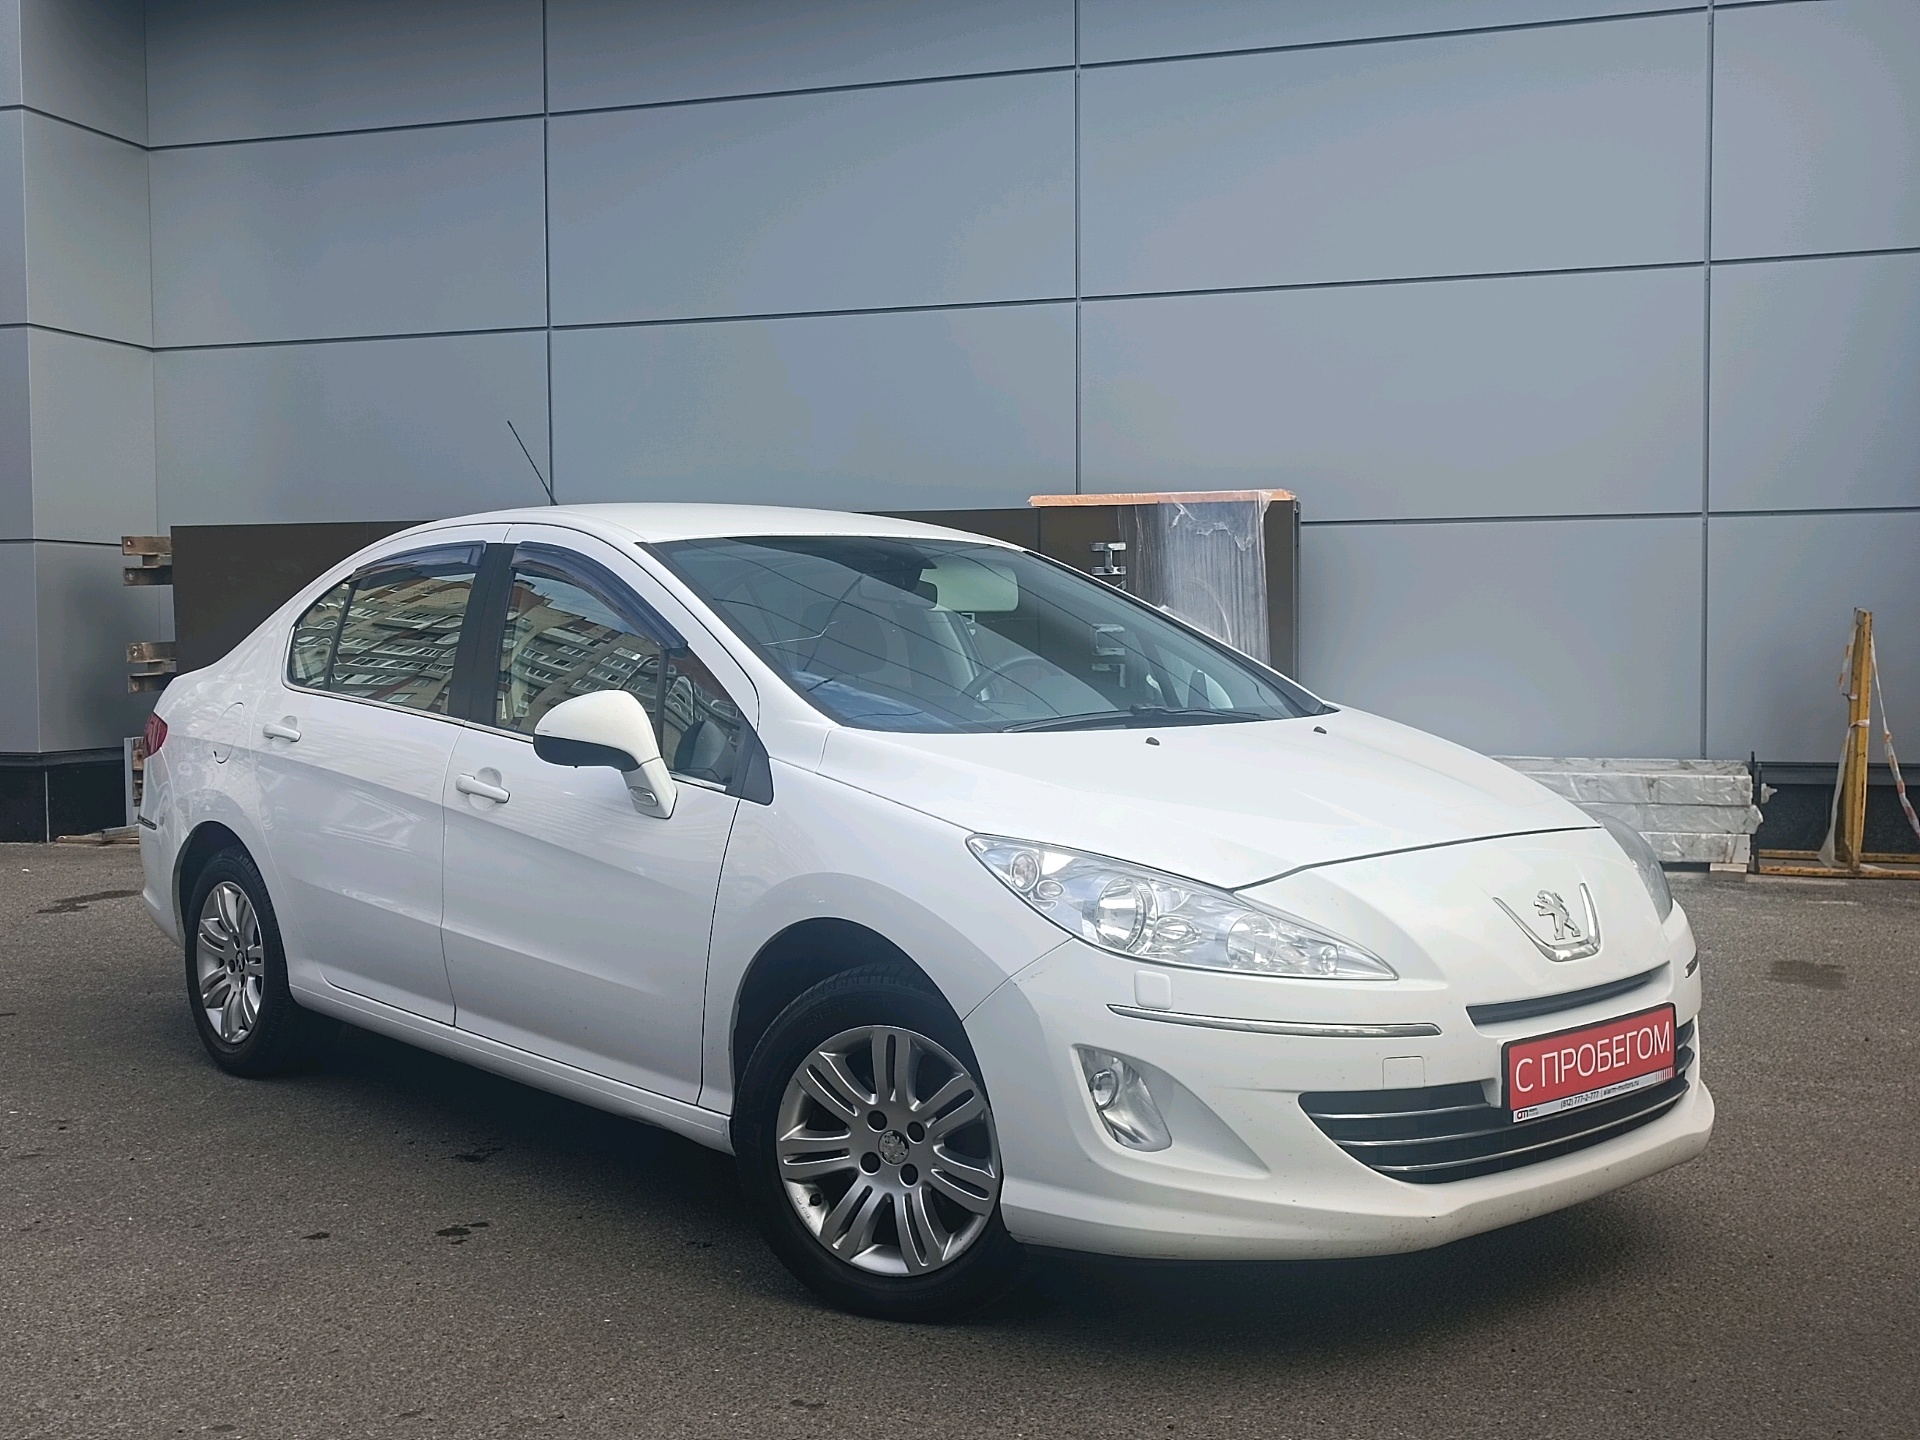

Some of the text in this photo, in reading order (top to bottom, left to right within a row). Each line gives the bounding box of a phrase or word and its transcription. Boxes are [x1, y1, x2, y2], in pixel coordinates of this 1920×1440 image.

[1515, 1021, 1671, 1093] С ПРОБЕГОМ
[1560, 1099, 1574, 1109] (812)
[1574, 1091, 1599, 1104] 777-2-777
